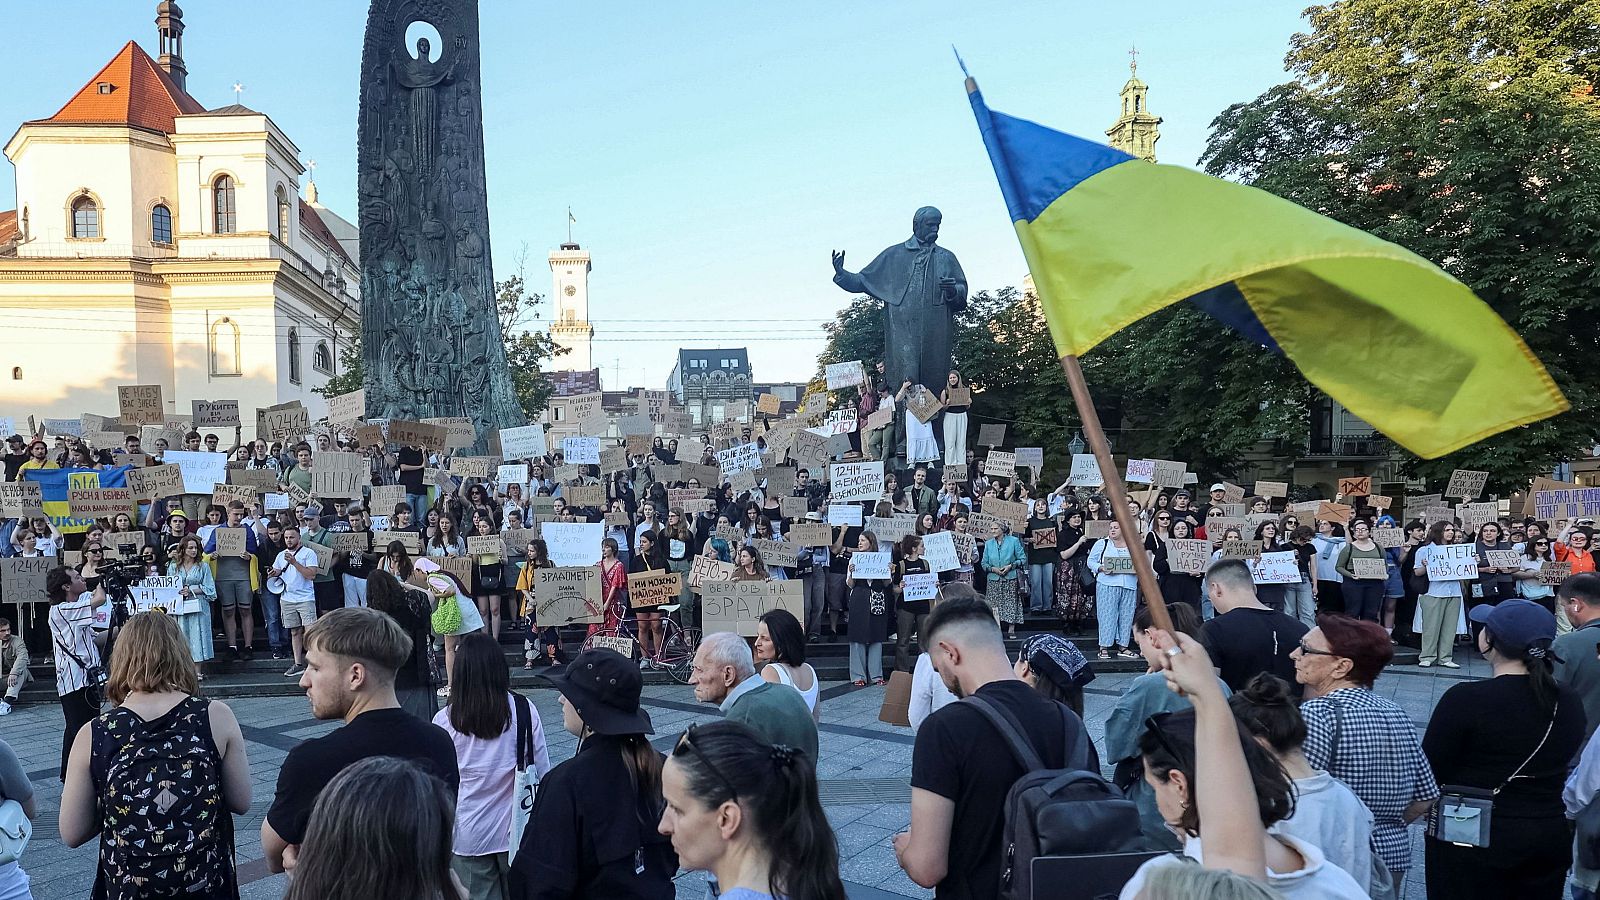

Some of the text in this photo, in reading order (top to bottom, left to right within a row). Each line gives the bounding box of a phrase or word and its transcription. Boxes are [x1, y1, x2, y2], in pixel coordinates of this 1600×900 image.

[120, 387, 158, 398] НЕ НАБУ
[122, 399, 157, 408] ВАС ЗНЕСЕ
[199, 404, 223, 412] РУКИ
[123, 411, 161, 421] ТАК МИ
[200, 416, 222, 424] НАБУ
[268, 411, 309, 432] 12414
[835, 466, 860, 477] 12414
[1455, 471, 1486, 480] БАЧИМО
[835, 473, 881, 489] ДЕМОНТАЖ
[132, 480, 157, 495] НАБУ
[215, 486, 240, 495] НАБУ
[72, 489, 131, 501] РУСНЯ ВБИВАЄ
[1536, 505, 1559, 520] ТЕПЕР
[1171, 541, 1207, 552] ХОЧЕТЕ
[1235, 548, 1259, 556] ЗРАДИ
[1446, 546, 1476, 560] ГЕТЬ
[1487, 550, 1518, 560] ВЕТО
[10, 559, 50, 574] 12414
[1176, 558, 1206, 570] НАБУ
[1456, 563, 1477, 577] САП
[541, 570, 595, 582] ЗРАДОМЕТР
[141, 590, 158, 602] НІ,
[631, 588, 664, 601] МАЙДАН
